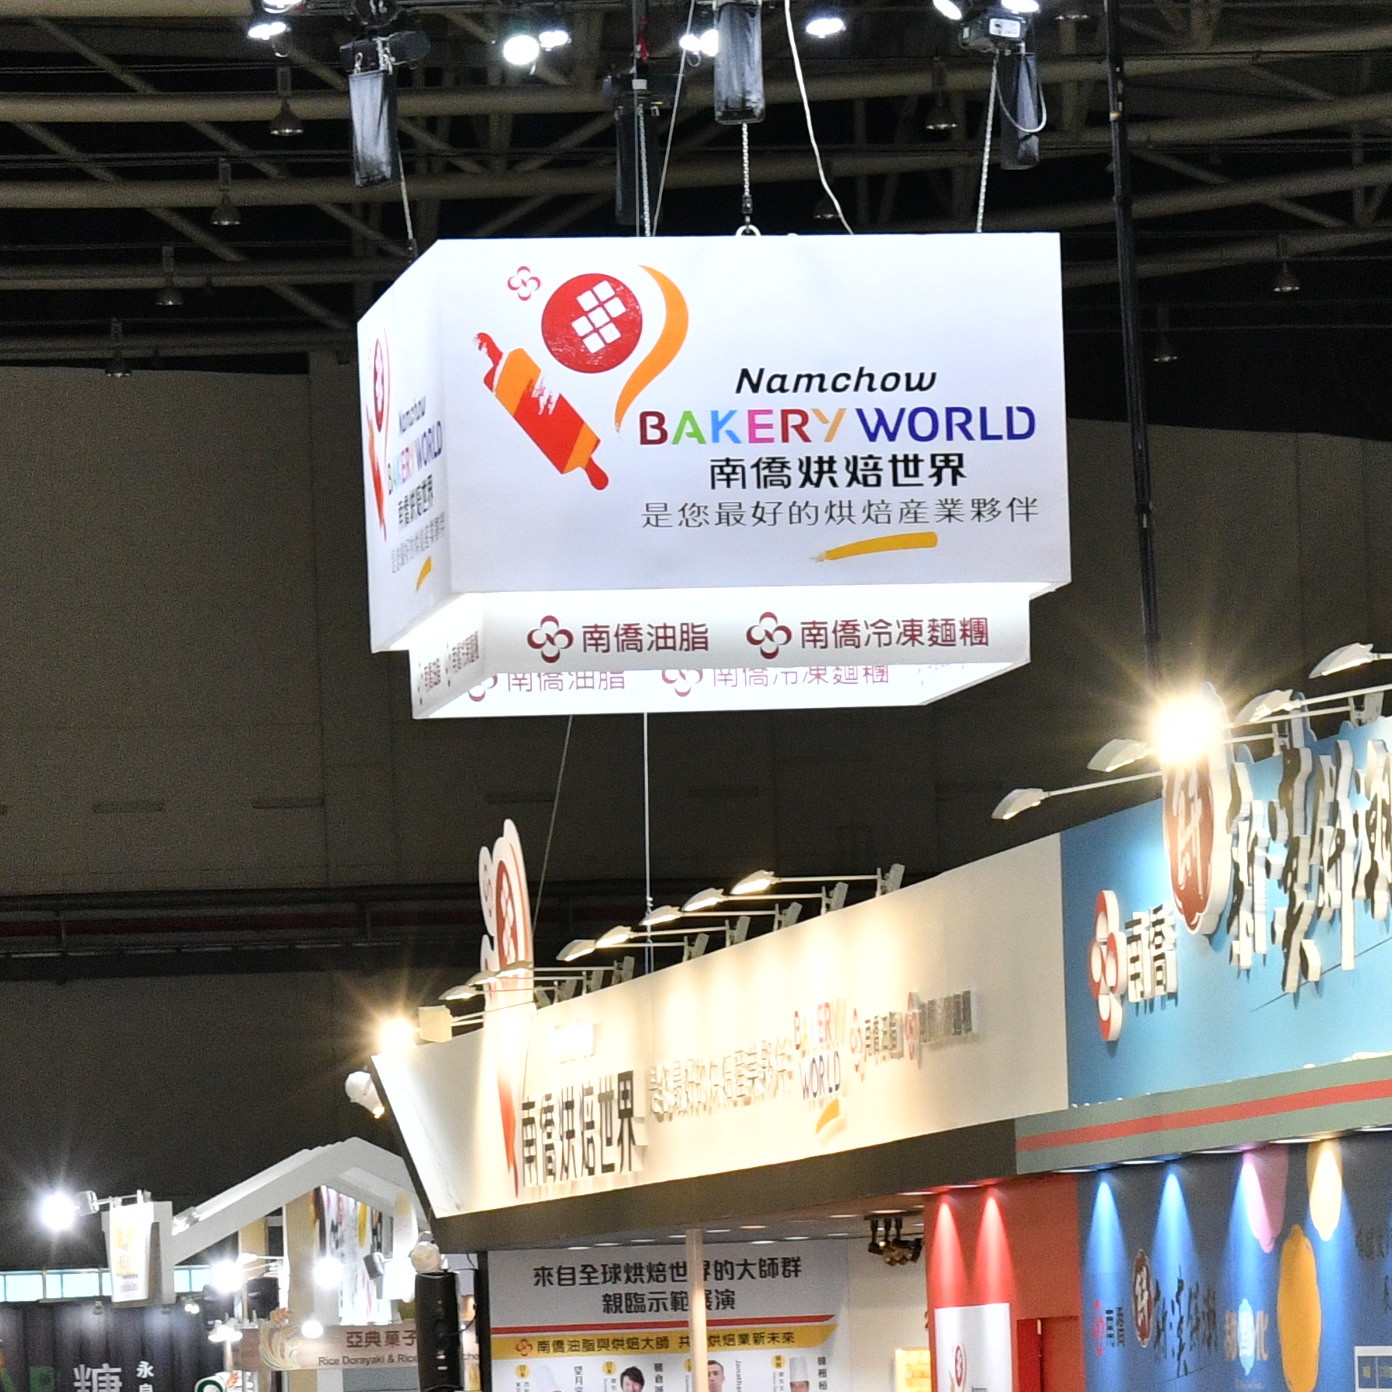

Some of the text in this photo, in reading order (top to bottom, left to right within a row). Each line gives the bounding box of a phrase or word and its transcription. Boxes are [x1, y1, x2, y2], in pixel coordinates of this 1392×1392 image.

[735, 366, 937, 395] Namchow
[639, 405, 1037, 447] BAKERY WORLD
[708, 453, 968, 491] 南僑烘焙世界
[581, 622, 710, 654] 南僑油脂
[677, 1331, 796, 1349] 共烘焙業新未來
[318, 1356, 340, 1367] Rice
[342, 1355, 385, 1367] Dorayaki
